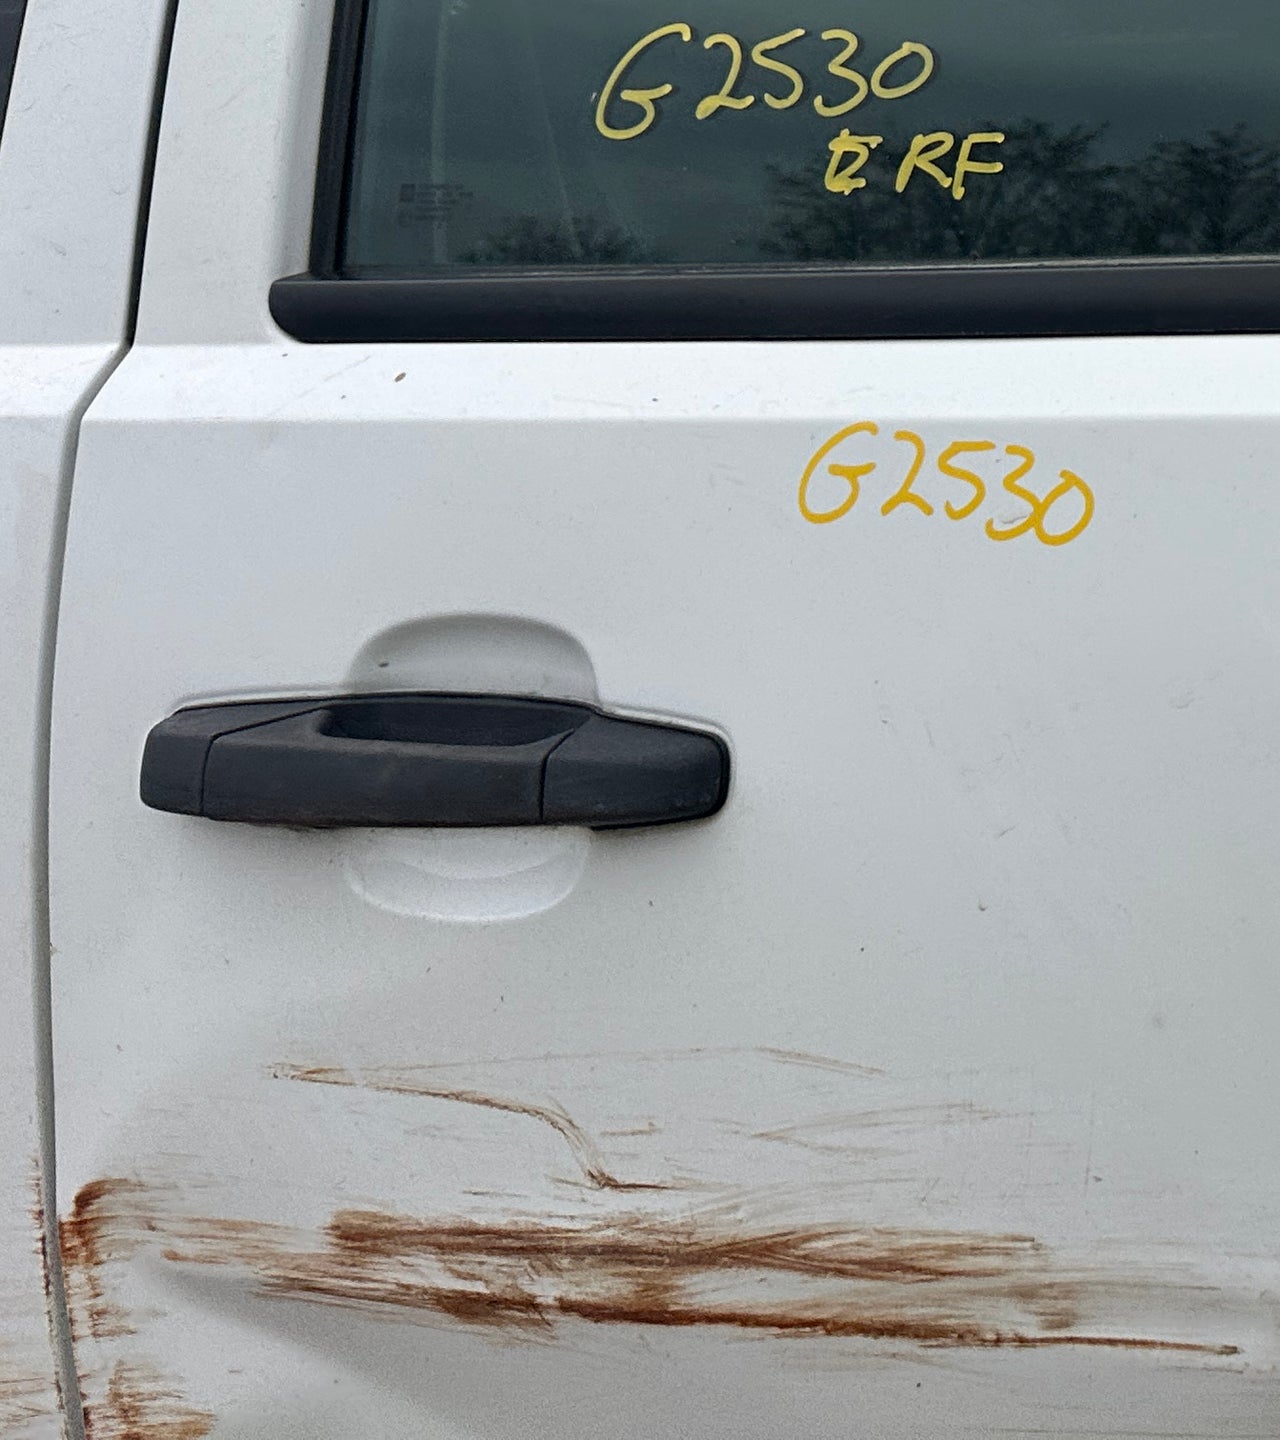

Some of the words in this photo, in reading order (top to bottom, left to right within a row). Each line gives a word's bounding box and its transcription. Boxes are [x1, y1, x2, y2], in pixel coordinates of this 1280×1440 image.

[595, 22, 935, 141] G2530
[895, 131, 1005, 201] RF
[798, 420, 1095, 547] G2530
